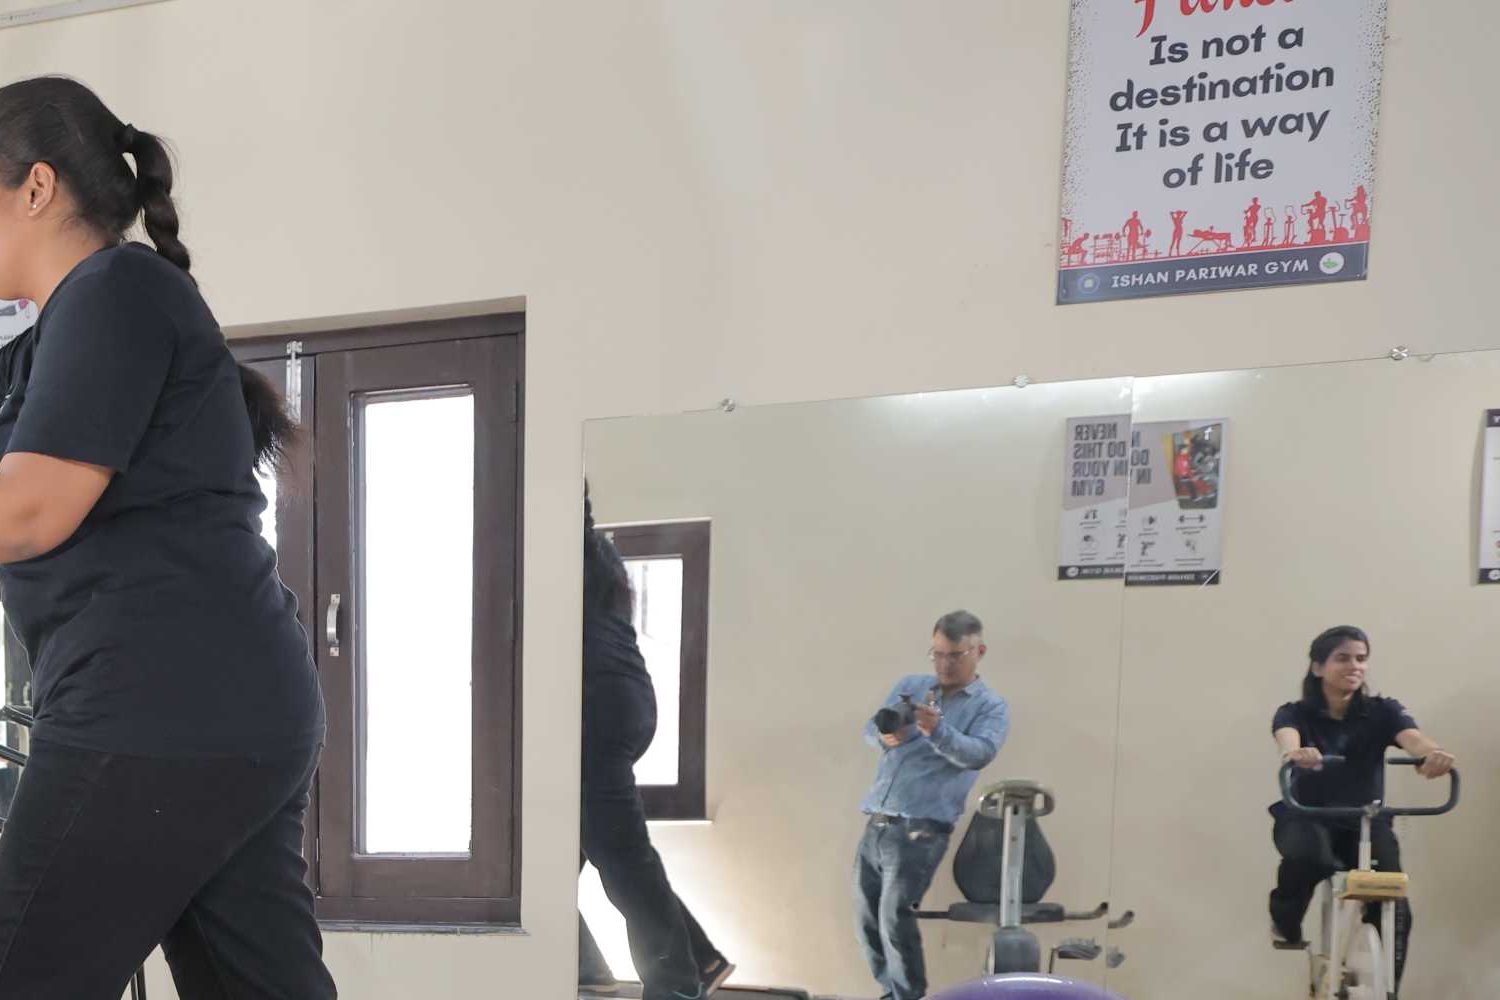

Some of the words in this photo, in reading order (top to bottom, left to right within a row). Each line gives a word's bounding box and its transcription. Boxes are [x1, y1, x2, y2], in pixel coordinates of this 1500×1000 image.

[1149, 35, 1189, 66] Is
[1201, 24, 1266, 59] not
[1277, 26, 1304, 50] a
[1109, 62, 1335, 112] destination
[1115, 122, 1148, 152] It
[1158, 118, 1190, 148] is
[1202, 121, 1228, 143] a
[1241, 109, 1331, 142] way
[1163, 153, 1204, 189] of
[1213, 148, 1275, 184] life
[1111, 272, 1169, 288] ISHAN
[1175, 263, 1259, 283] PARIWAR
[1265, 258, 1309, 275] GYM
